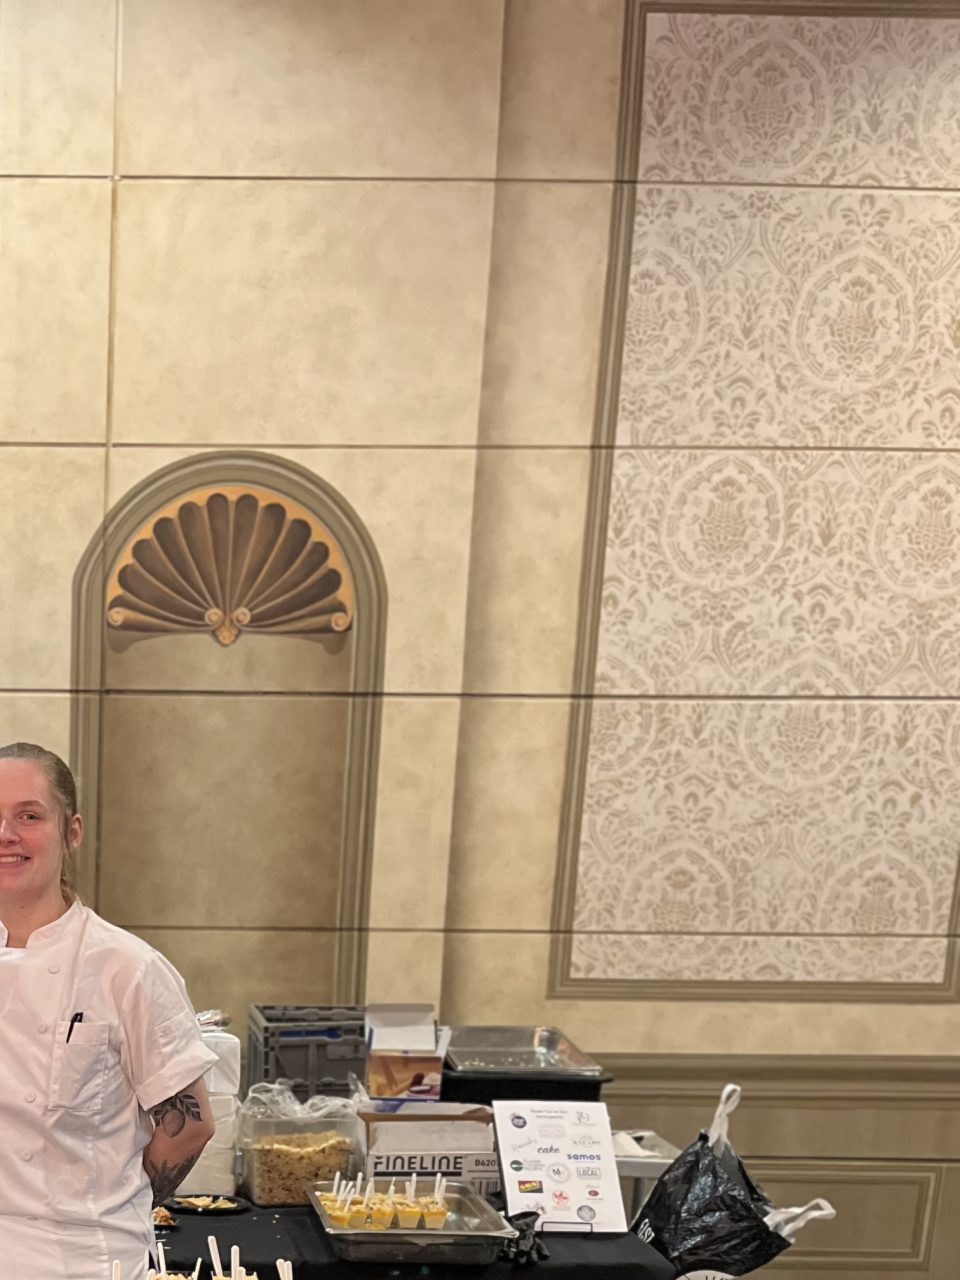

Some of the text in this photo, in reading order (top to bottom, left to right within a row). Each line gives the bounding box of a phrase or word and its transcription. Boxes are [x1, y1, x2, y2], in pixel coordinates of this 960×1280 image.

[537, 1145, 560, 1154] cake
[374, 1156, 463, 1170] FINELINE
[578, 1169, 599, 1177] LOCAL
